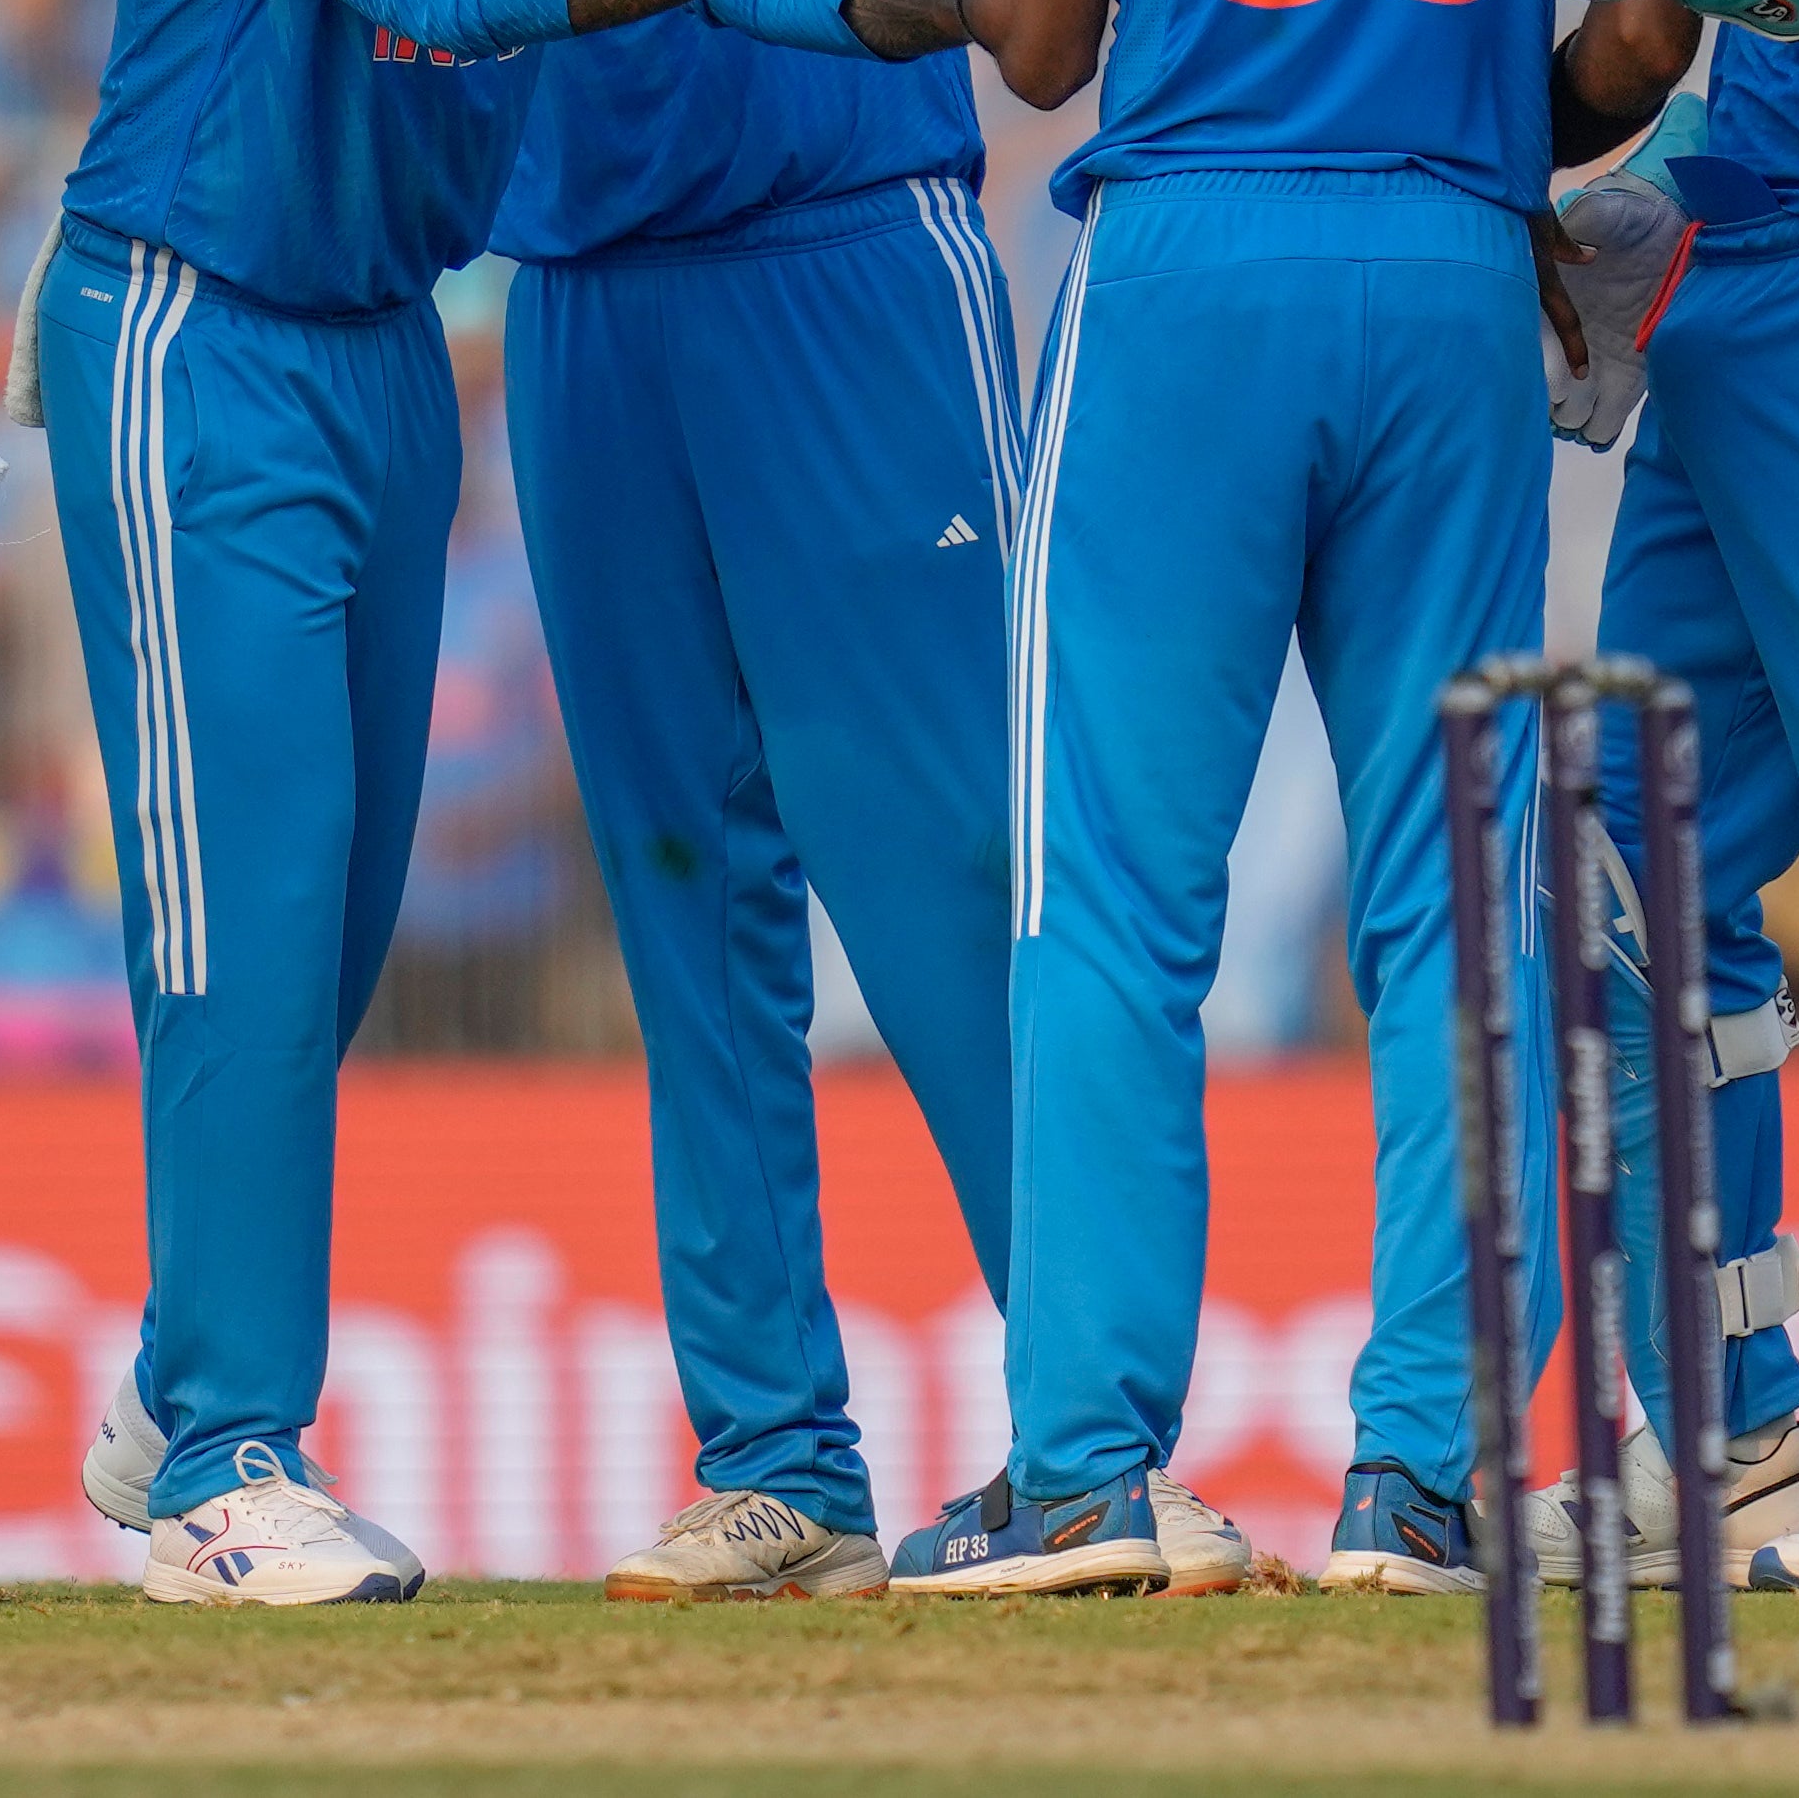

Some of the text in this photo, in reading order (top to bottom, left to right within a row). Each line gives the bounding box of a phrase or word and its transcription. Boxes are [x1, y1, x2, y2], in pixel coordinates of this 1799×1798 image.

[944, 1533, 989, 1565] HP 33
[278, 1561, 307, 1570] SKY
